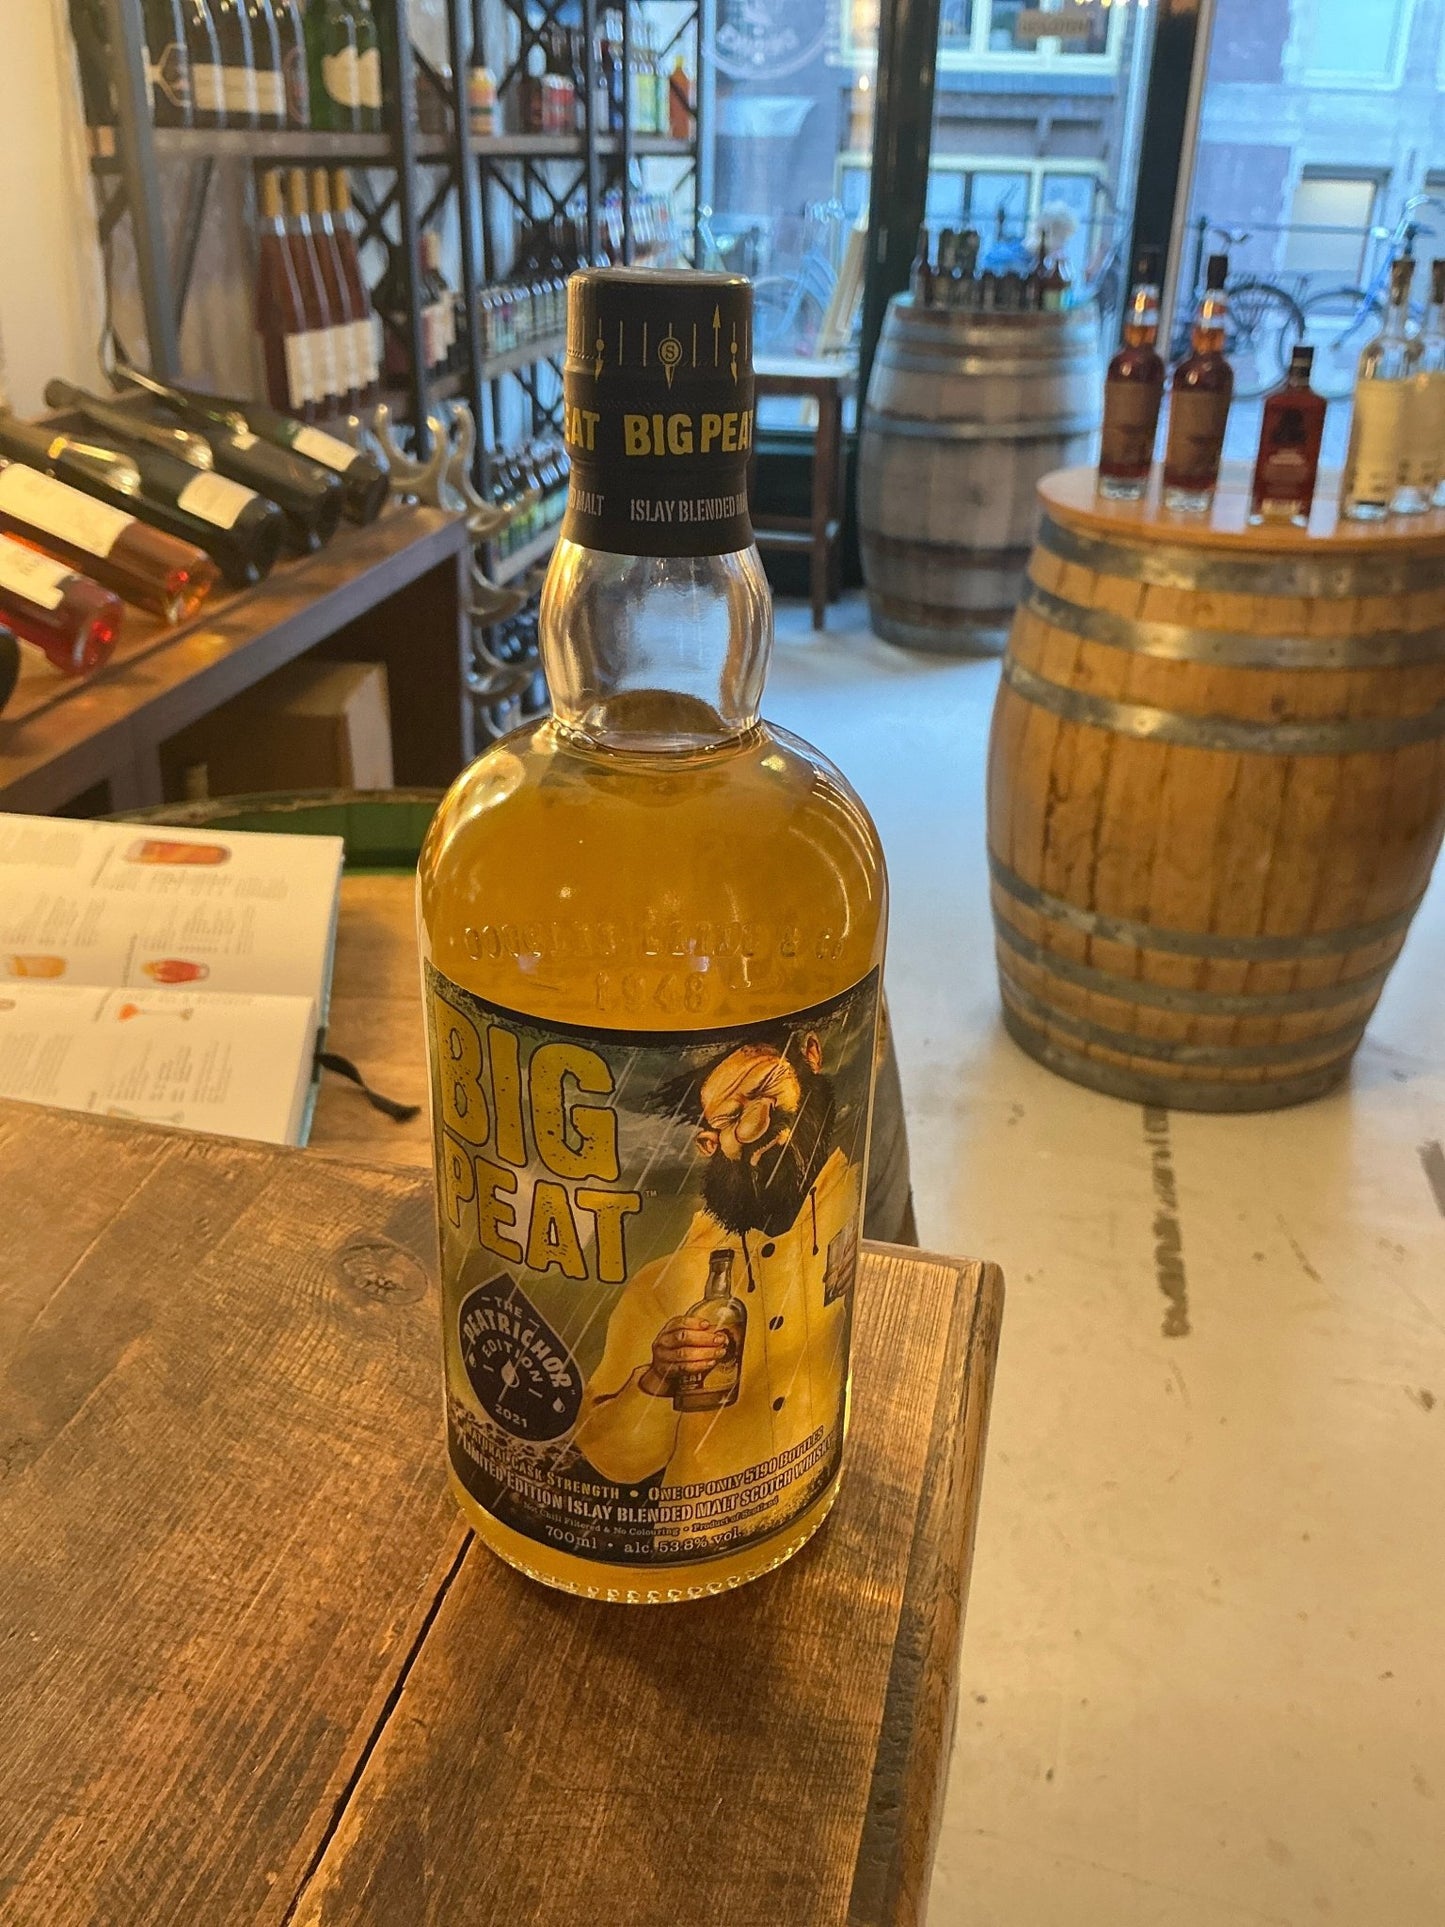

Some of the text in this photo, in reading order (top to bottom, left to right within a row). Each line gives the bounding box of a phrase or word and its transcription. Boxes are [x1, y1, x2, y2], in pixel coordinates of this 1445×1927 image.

[623, 413, 694, 457] BIG
[630, 497, 677, 523] ISLAY
[678, 495, 736, 522] BLENDED
[435, 989, 622, 1183] BIG
[442, 1130, 643, 1284] PEAT
[482, 1338, 544, 1382] EDITION
[494, 1403, 528, 1428] 2021
[511, 1456, 543, 1482] CASK
[546, 1471, 620, 1500] STRENGTH
[648, 1486, 682, 1501] ONE
[684, 1482, 704, 1500] OF
[705, 1472, 744, 1496] ONLY
[779, 1425, 824, 1469] BOTTLES
[507, 1471, 563, 1509] EDITION
[567, 1495, 613, 1520] ISLAY
[617, 1504, 692, 1524] BLENDED
[695, 1493, 739, 1519] MALT
[740, 1468, 793, 1507] SCOTCH
[545, 1525, 598, 1549] 700ml
[691, 1516, 729, 1533] Product
